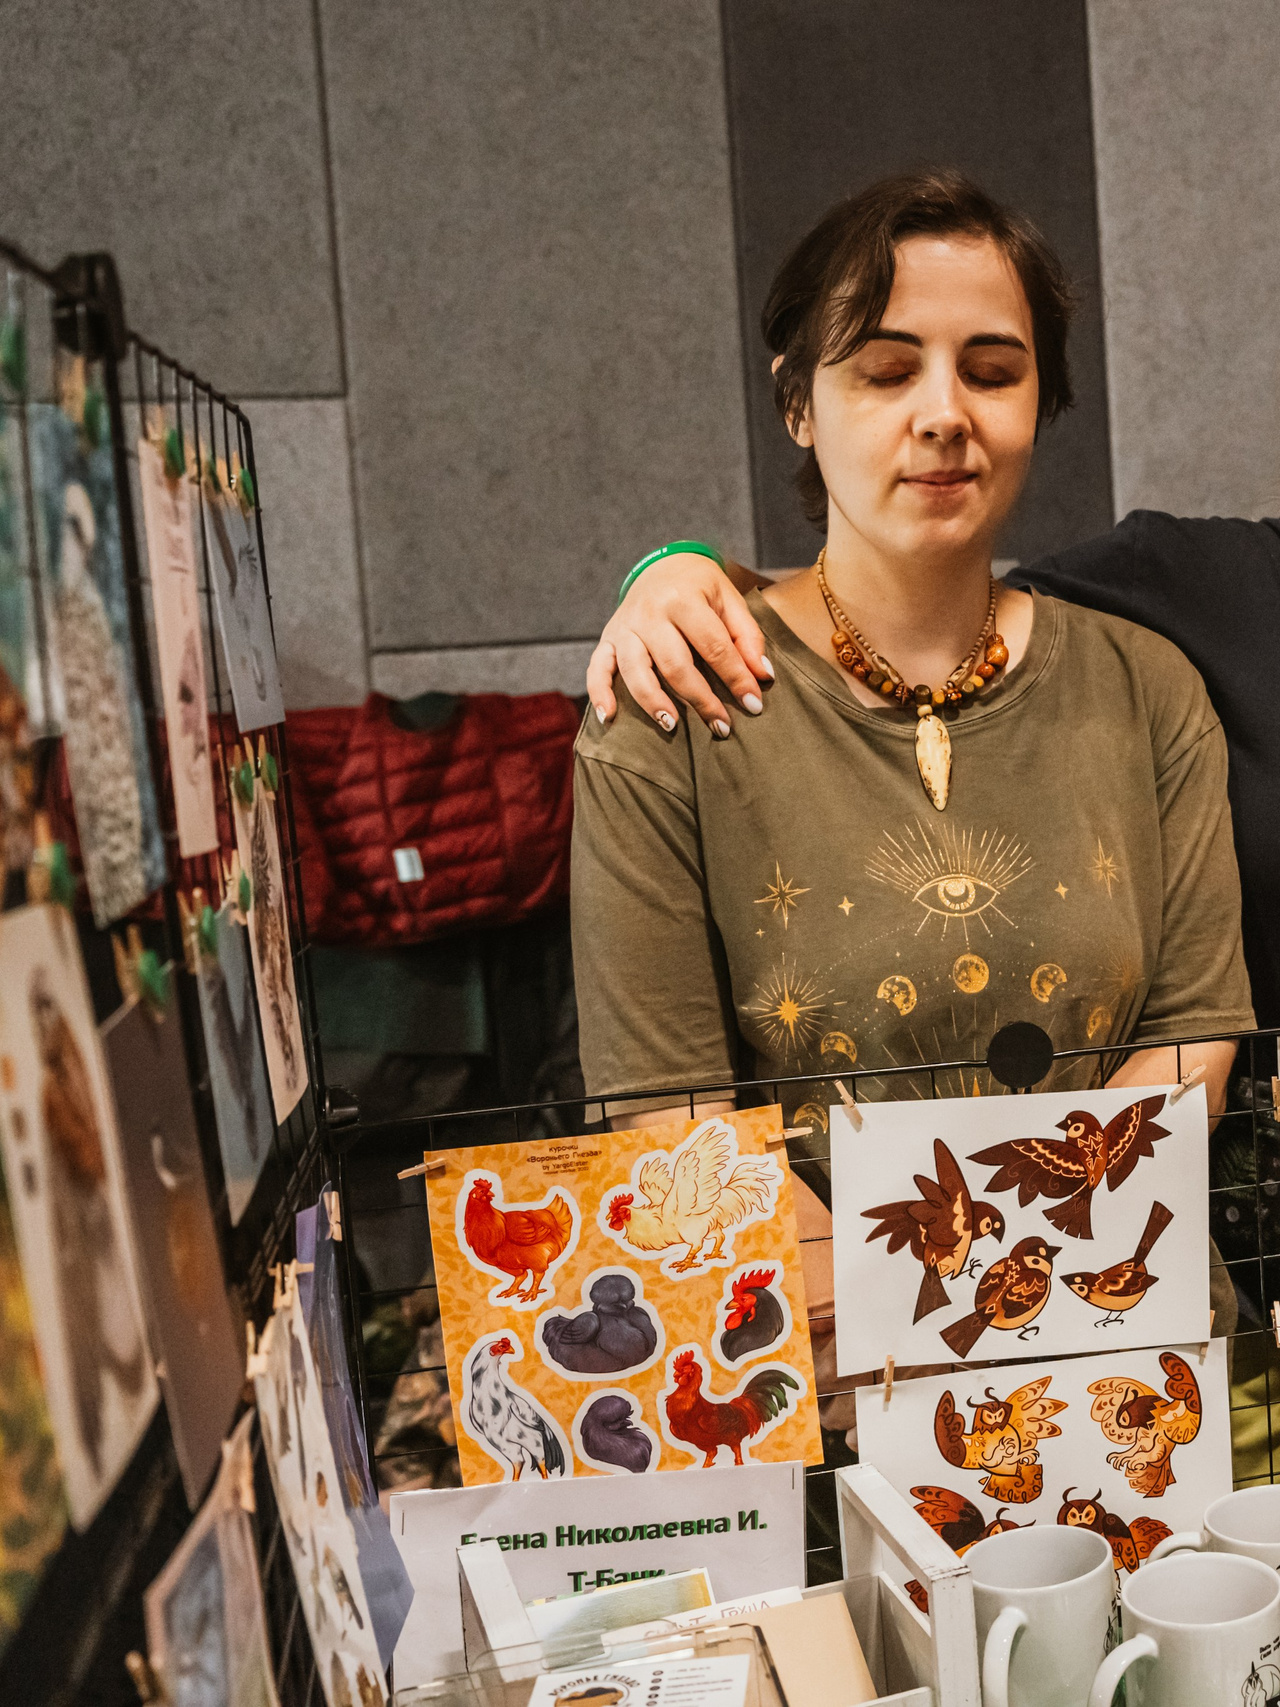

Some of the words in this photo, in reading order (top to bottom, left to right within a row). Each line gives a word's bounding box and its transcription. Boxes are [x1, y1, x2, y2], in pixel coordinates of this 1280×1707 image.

[461, 1532, 548, 1552] Еена
[555, 1516, 730, 1547] Николаевна
[738, 1509, 767, 1532] И.
